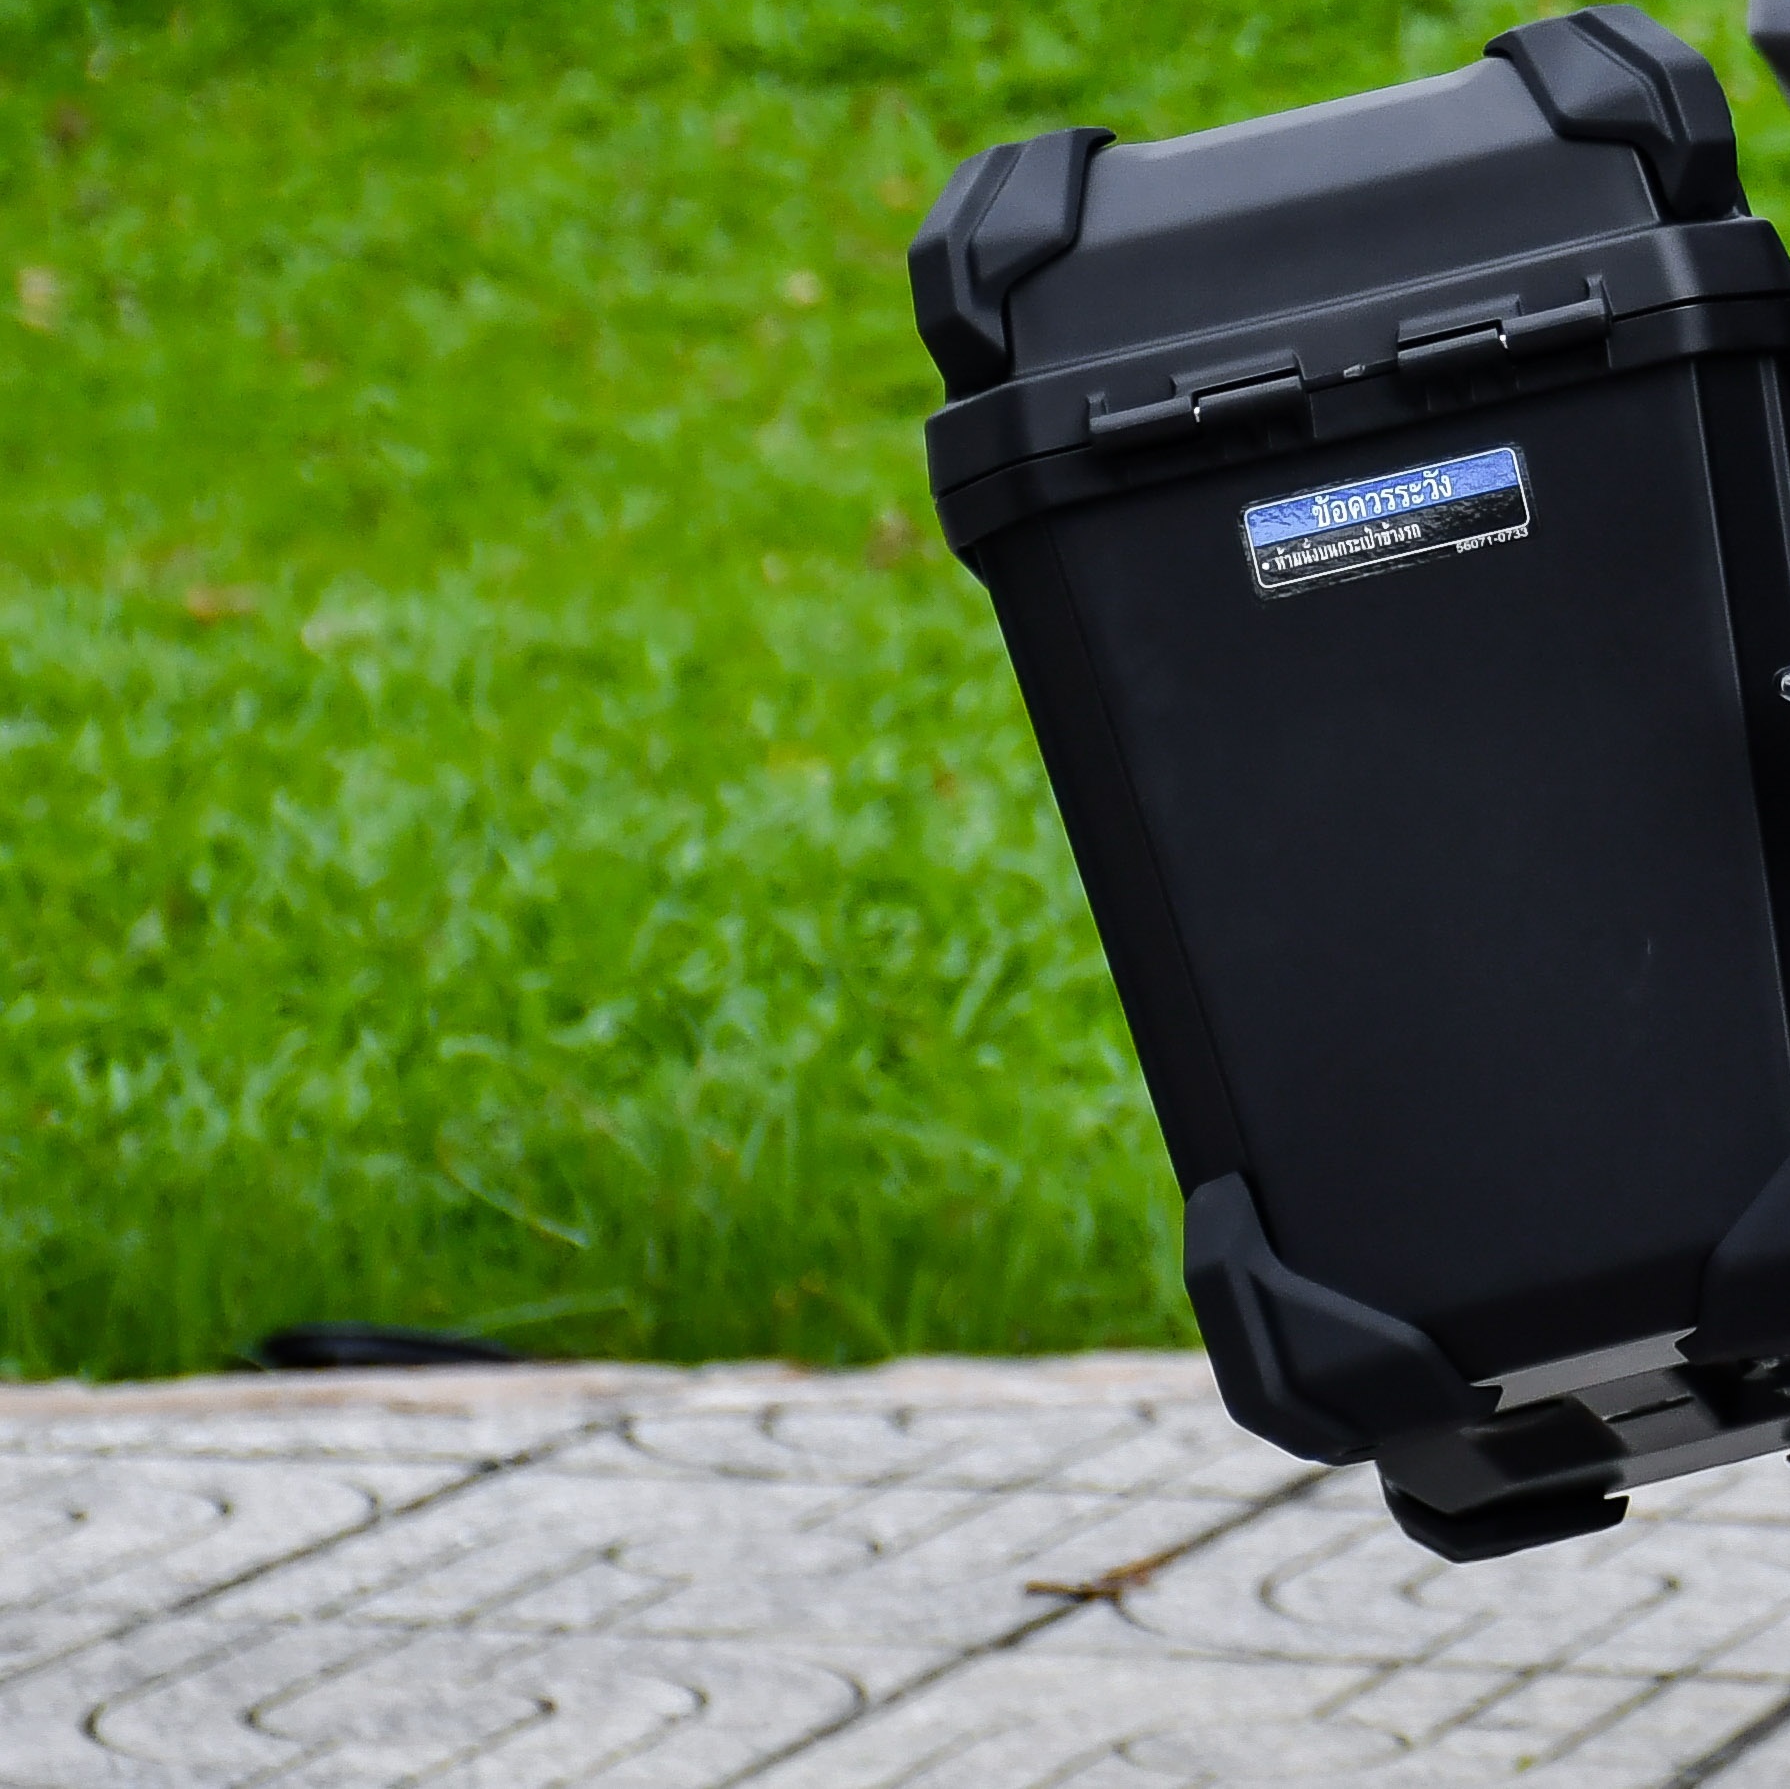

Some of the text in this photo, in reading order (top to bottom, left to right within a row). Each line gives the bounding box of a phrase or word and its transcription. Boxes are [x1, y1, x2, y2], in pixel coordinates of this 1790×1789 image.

[1311, 468, 1453, 528] ข้อควรระวัง
